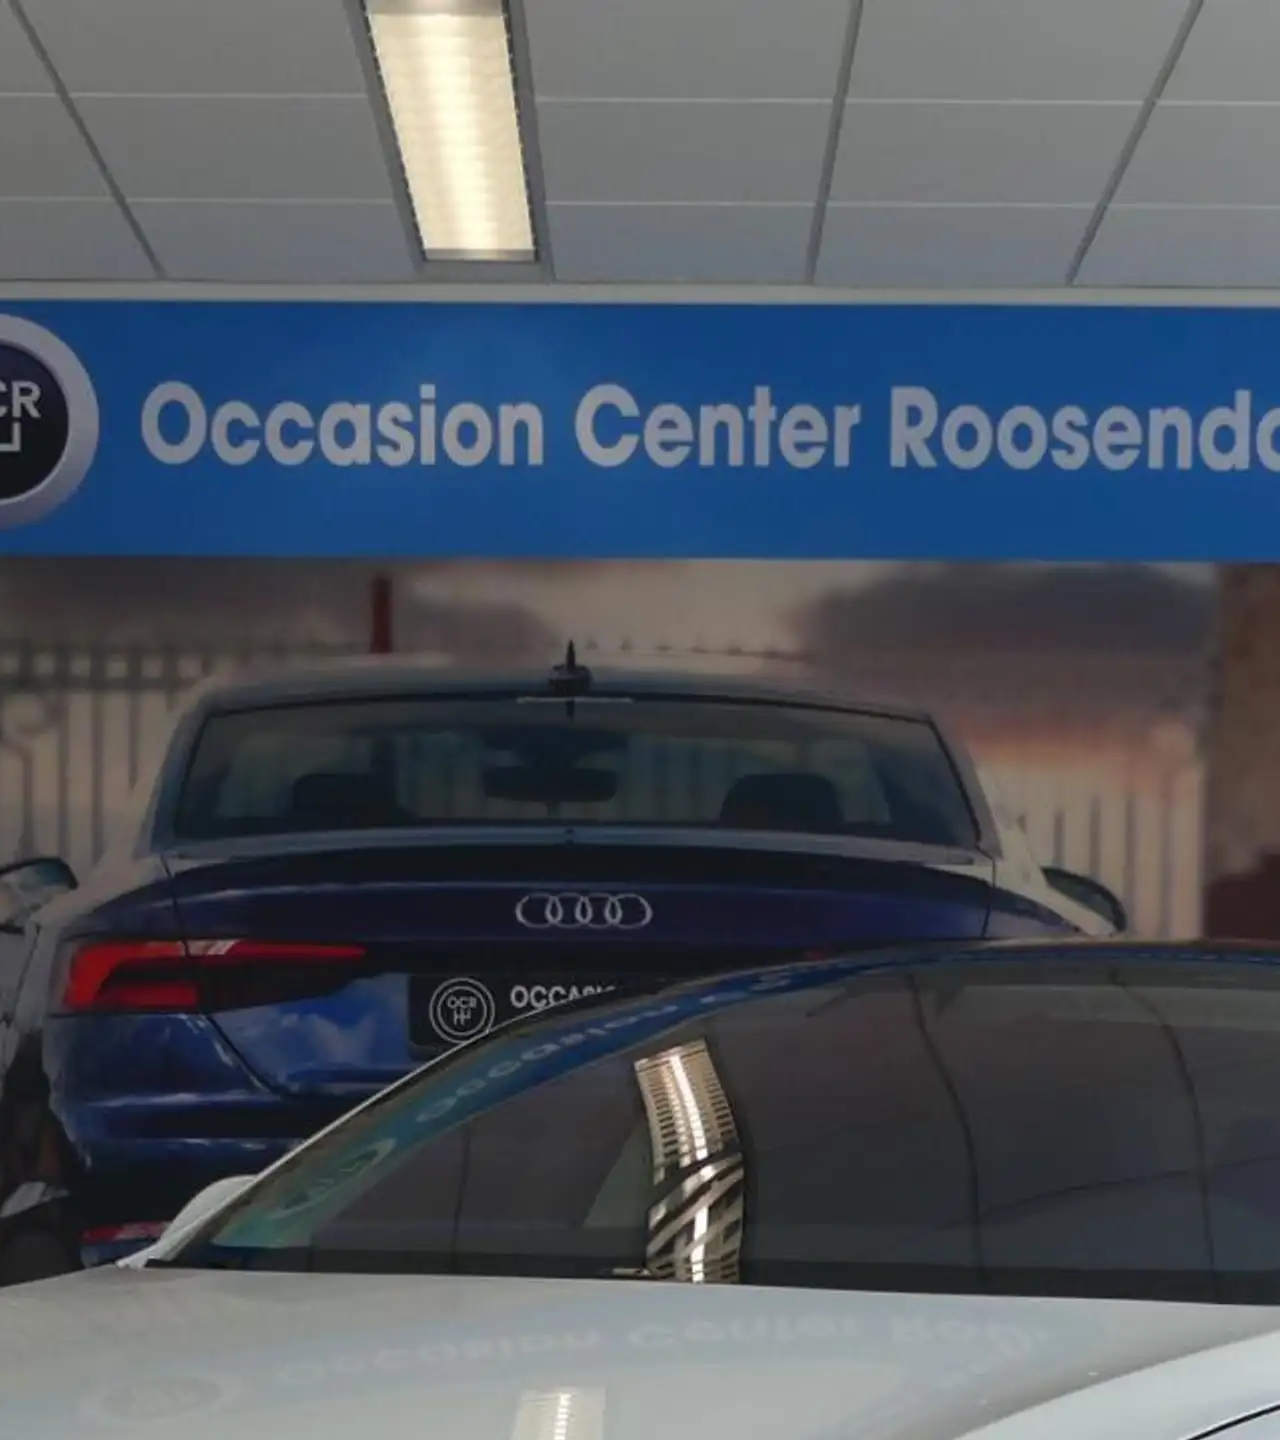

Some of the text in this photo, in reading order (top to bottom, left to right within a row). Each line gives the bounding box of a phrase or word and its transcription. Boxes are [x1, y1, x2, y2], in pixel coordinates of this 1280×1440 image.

[141, 381, 544, 467] Occasion
[575, 384, 860, 468] Center
[510, 984, 616, 1010] OCCA
